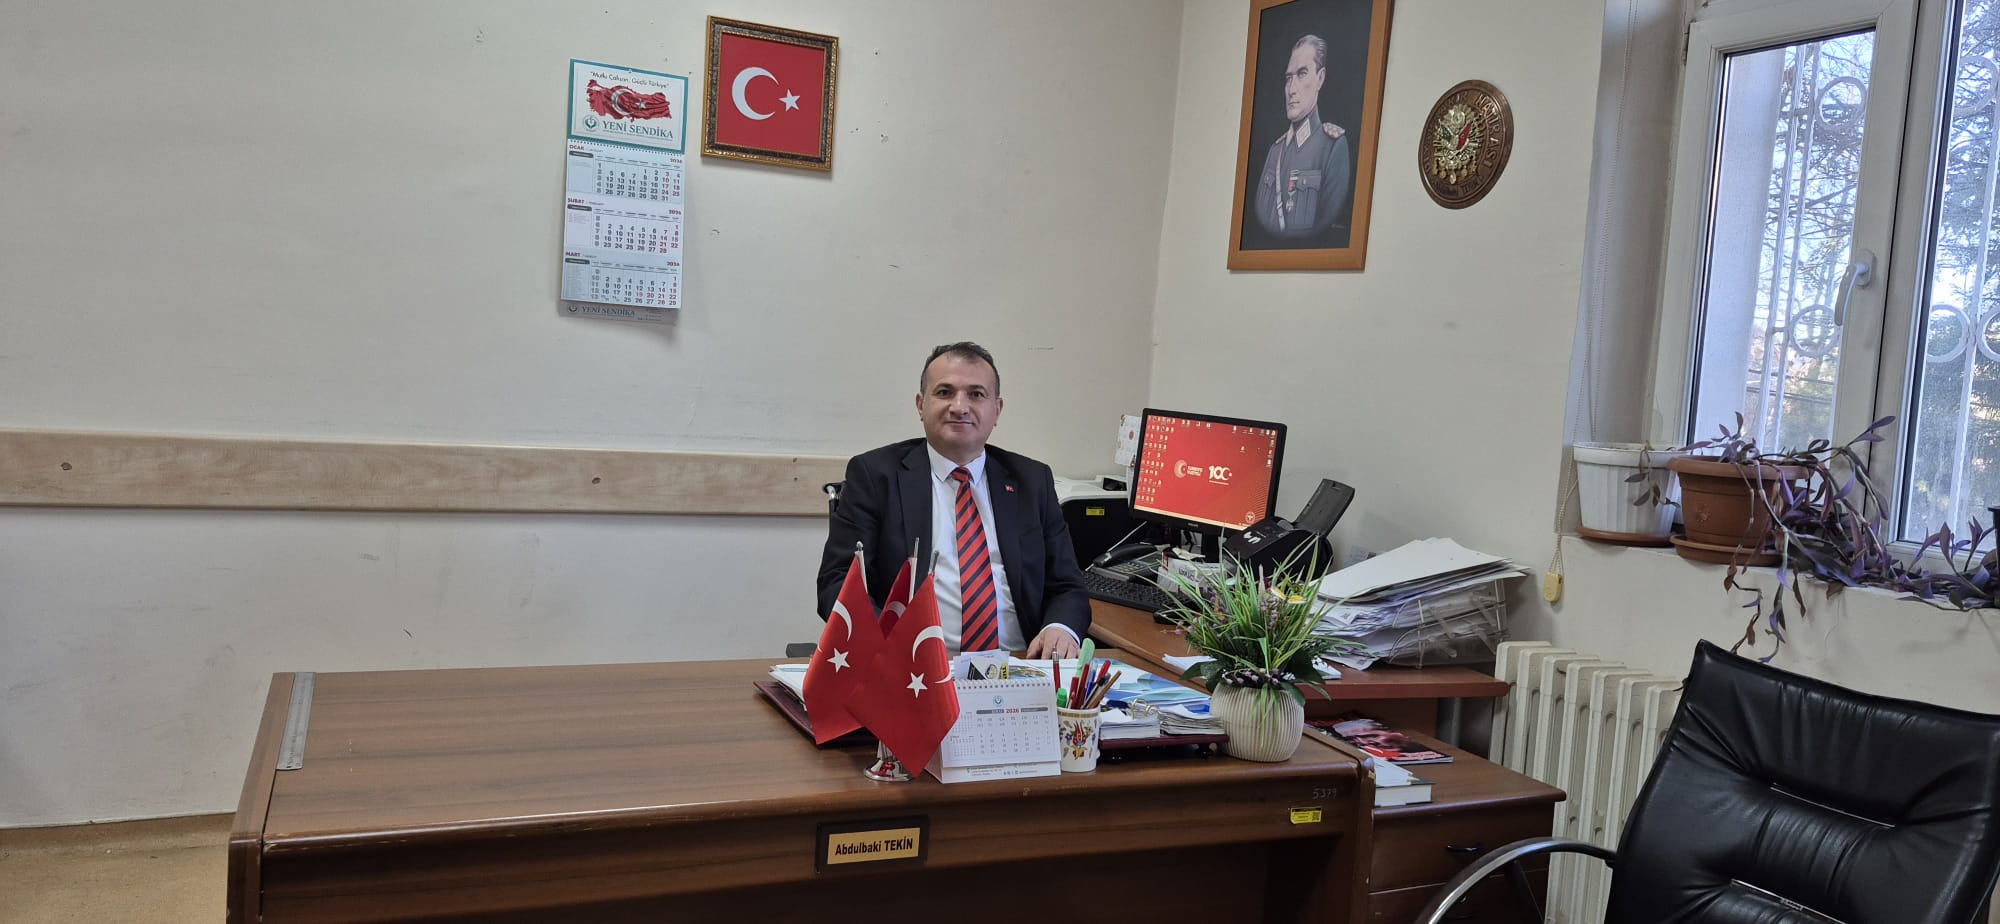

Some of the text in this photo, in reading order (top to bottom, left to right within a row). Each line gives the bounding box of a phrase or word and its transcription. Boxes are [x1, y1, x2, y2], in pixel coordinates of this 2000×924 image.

[602, 120, 673, 139] YENİ SENDİKA
[835, 836, 914, 856] Abdulbaki TEKİN
